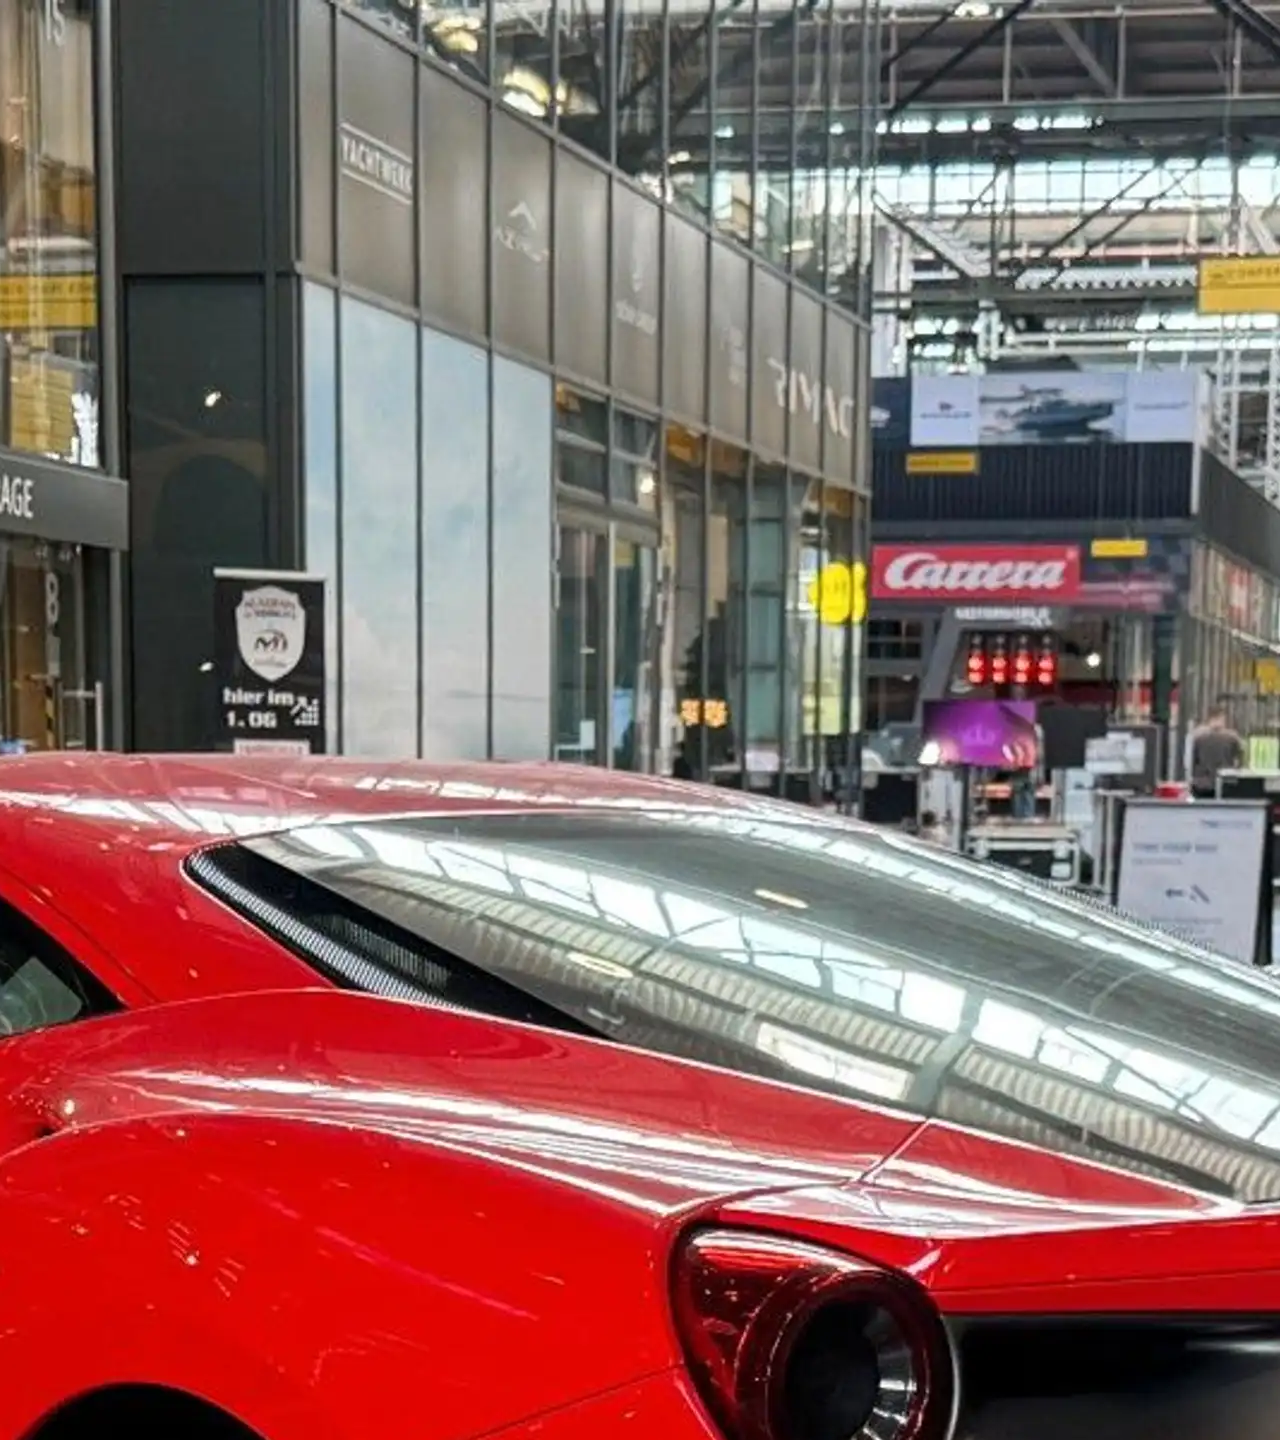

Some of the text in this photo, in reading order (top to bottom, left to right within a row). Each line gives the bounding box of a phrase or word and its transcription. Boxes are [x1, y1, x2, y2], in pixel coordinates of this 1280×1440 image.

[884, 552, 1065, 590] Carrera
[222, 686, 294, 706] hier im
